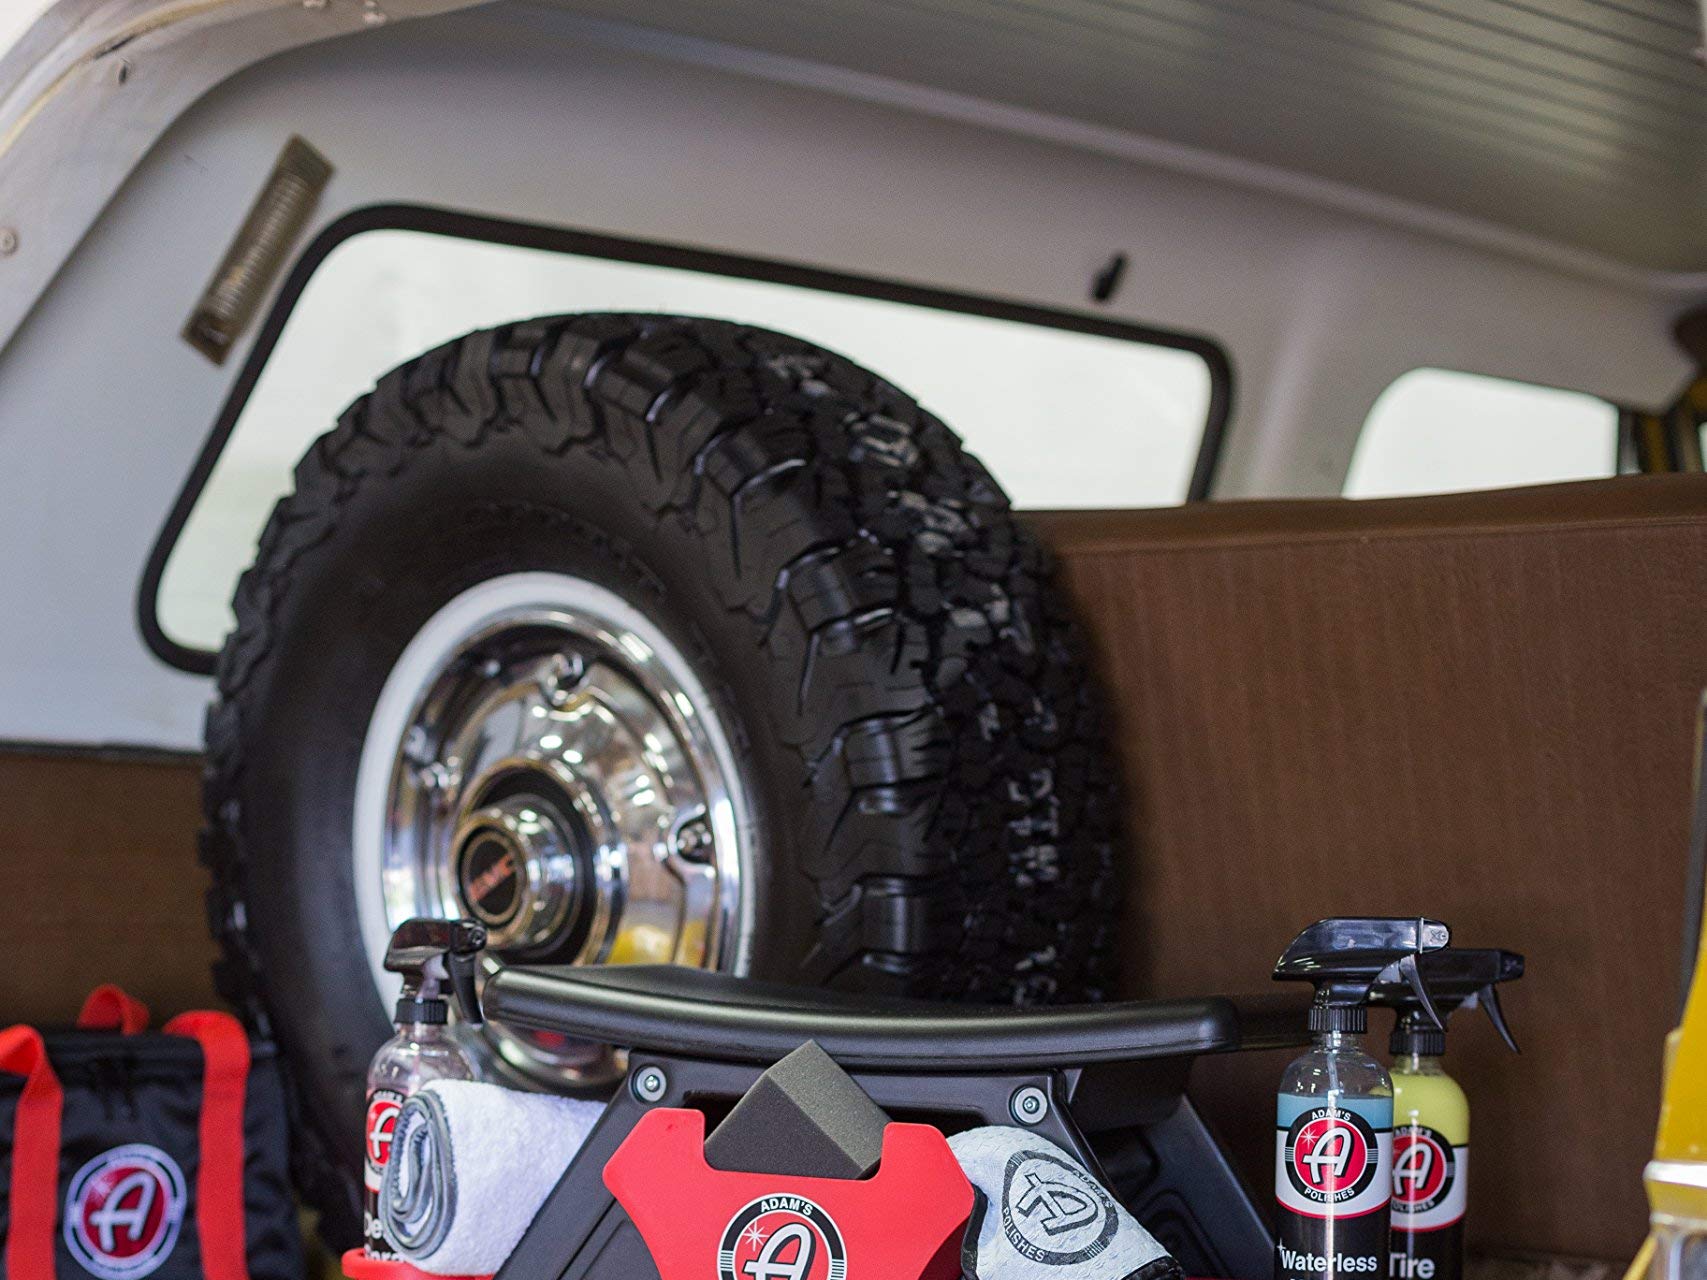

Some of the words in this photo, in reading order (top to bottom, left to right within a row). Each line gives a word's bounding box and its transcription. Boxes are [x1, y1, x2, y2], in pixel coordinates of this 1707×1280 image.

[1311, 1110, 1352, 1121] ADAM'S
[1302, 1126, 1354, 1185] A
[1304, 1187, 1355, 1202] POLISHES
[760, 1198, 813, 1216] ADAM'S
[1002, 1206, 1047, 1262] POLISHES
[1281, 1250, 1378, 1273] Waterless
